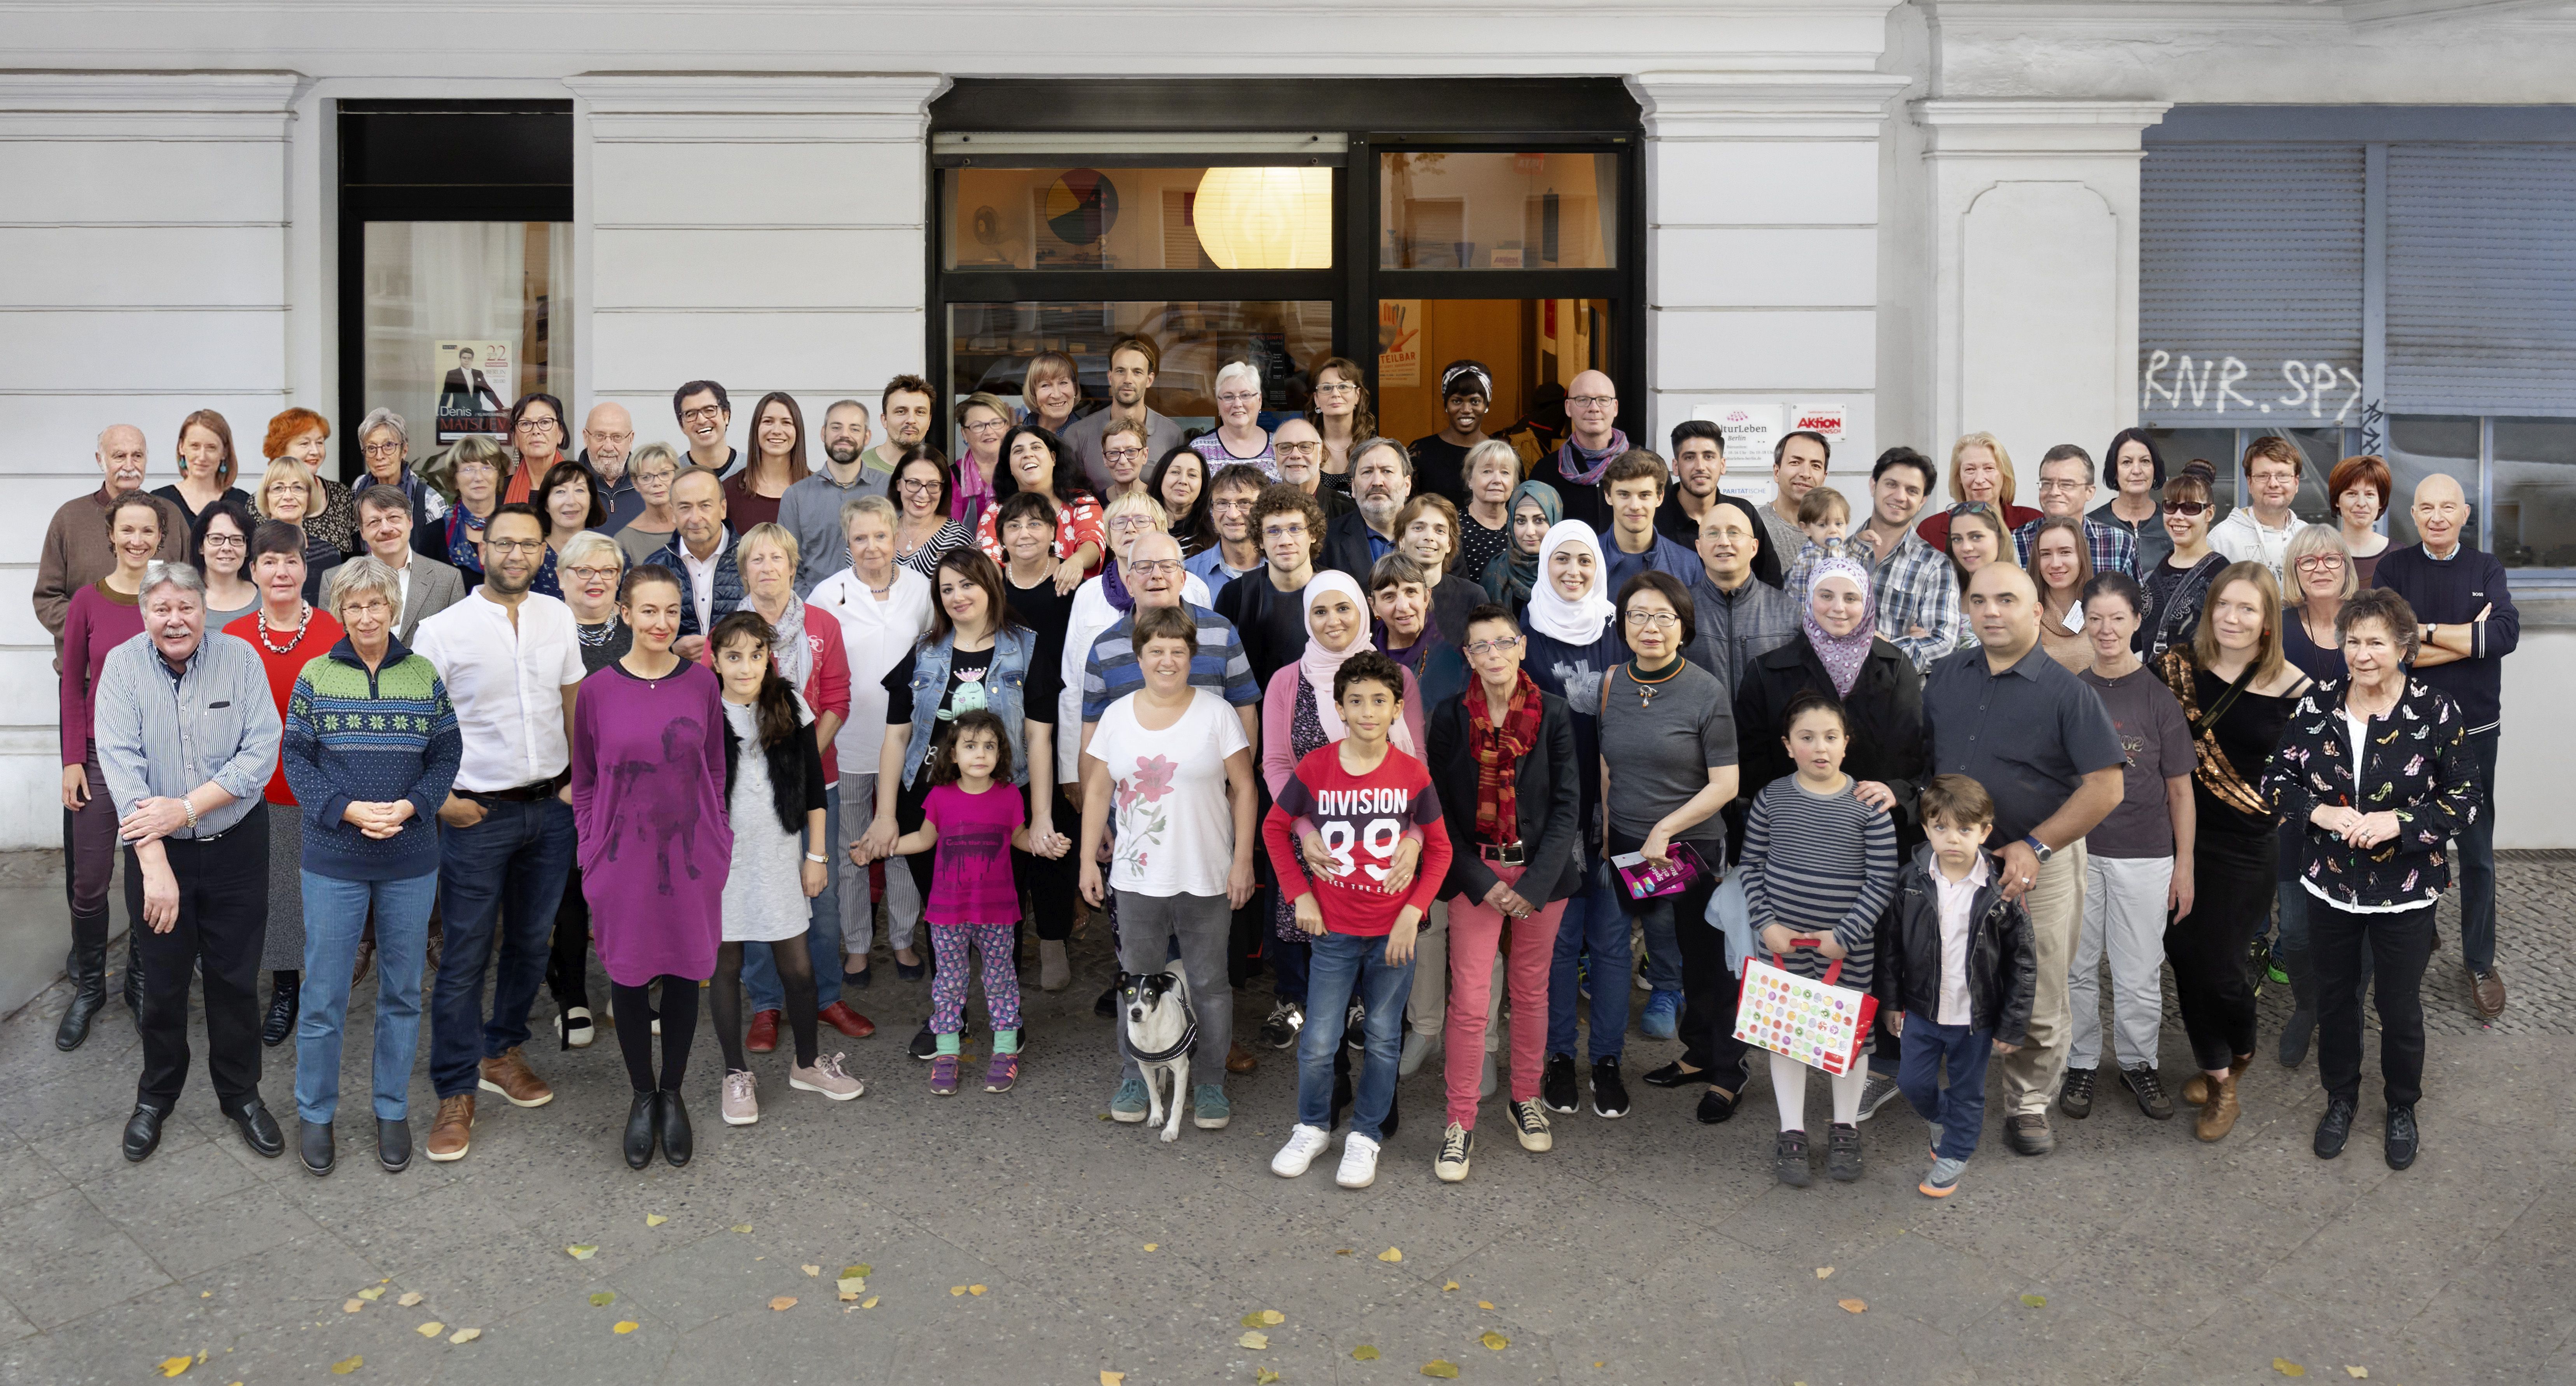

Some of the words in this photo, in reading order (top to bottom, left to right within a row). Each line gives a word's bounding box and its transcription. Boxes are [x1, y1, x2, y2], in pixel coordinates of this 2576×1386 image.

[487, 345, 506, 361] 22
[1380, 352, 1416, 364] TEILBAR
[440, 406, 472, 416] Denis
[440, 418, 508, 430] MATSUEV
[1720, 424, 1767, 433] lturLeben
[1318, 788, 1408, 816] DIVISION
[1320, 818, 1400, 881] 89
[1648, 866, 1664, 882] Spiel
[1660, 867, 1670, 877] ein
[1328, 879, 1344, 888] TER
[1351, 884, 1370, 892] THE
